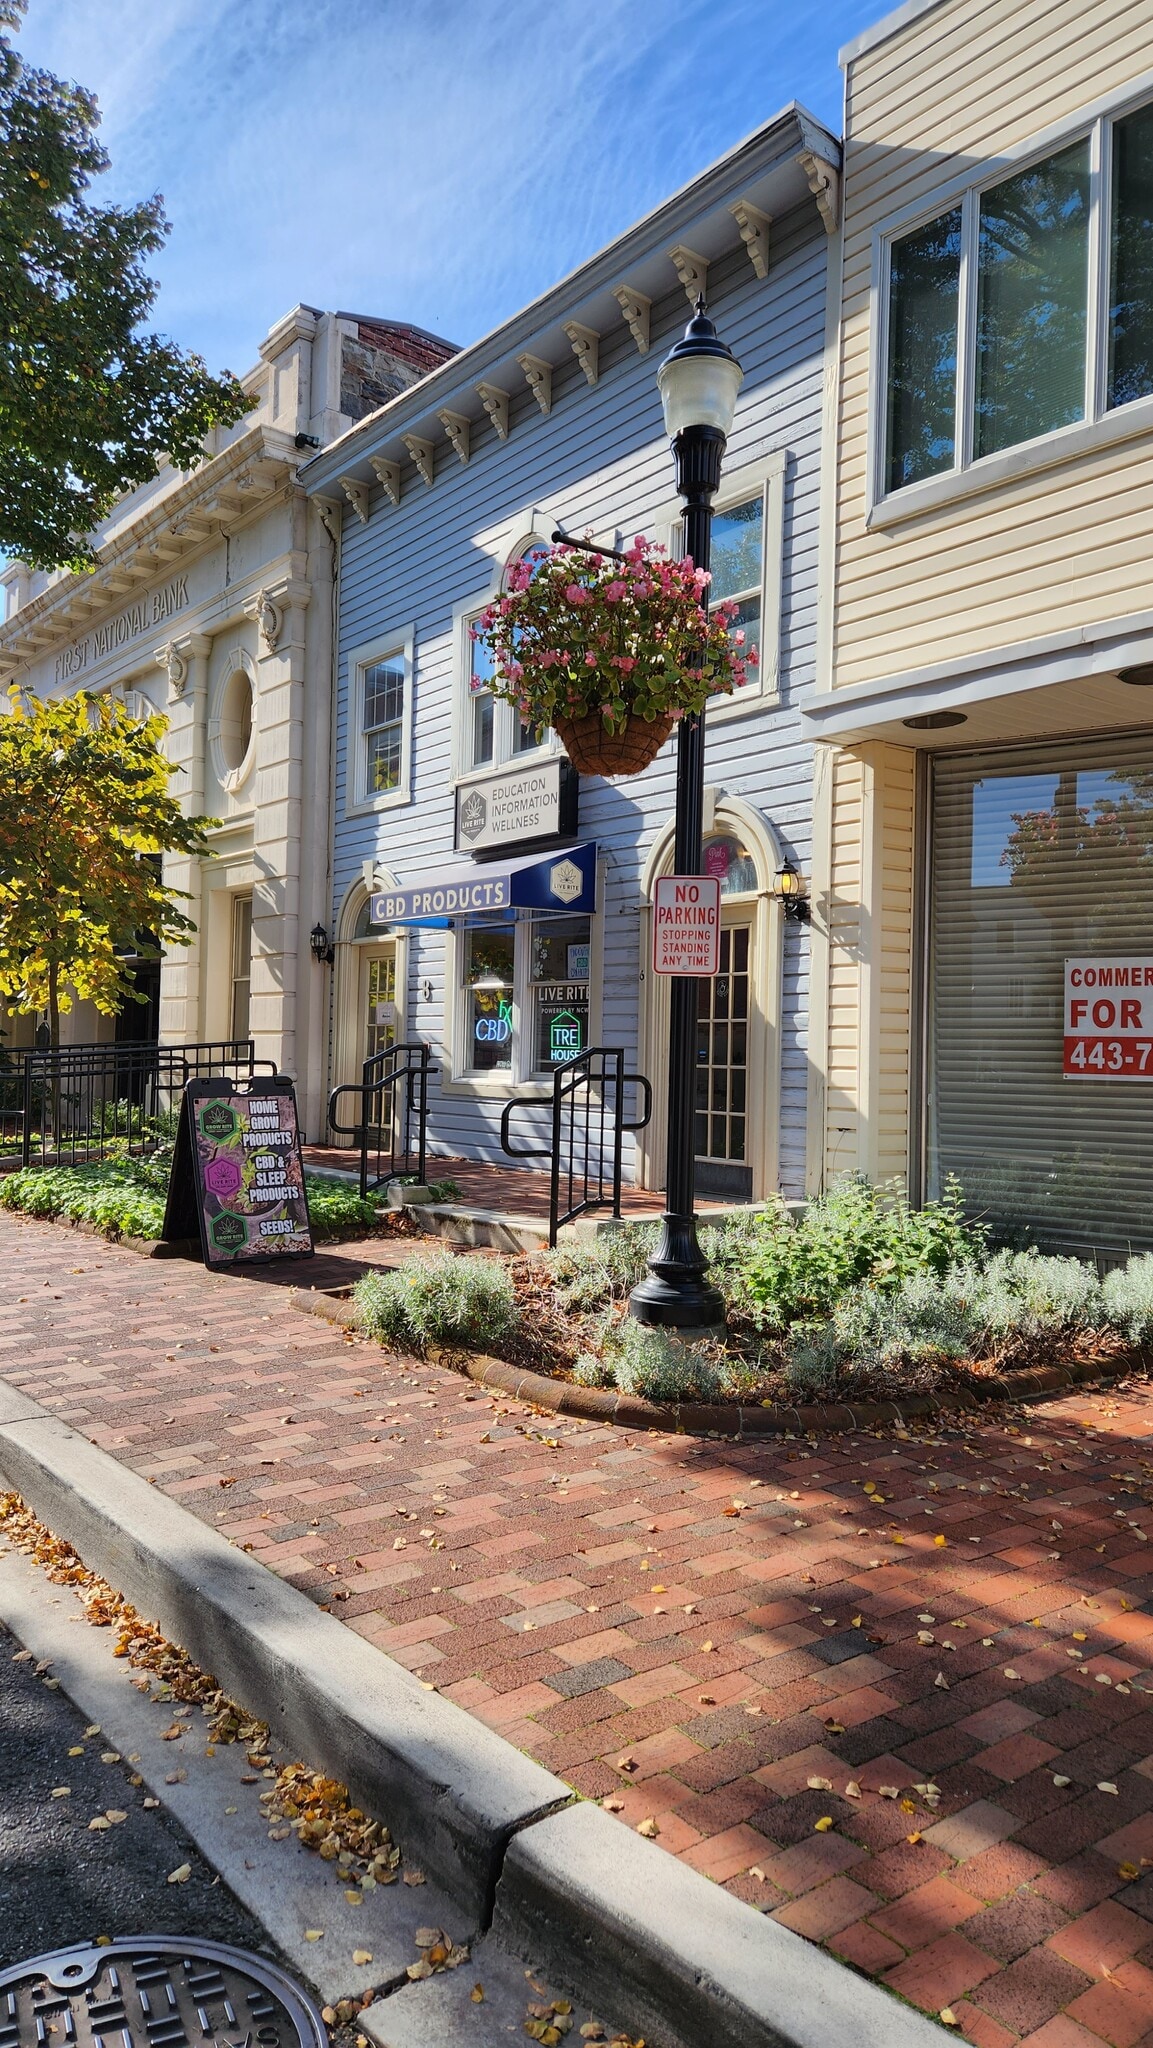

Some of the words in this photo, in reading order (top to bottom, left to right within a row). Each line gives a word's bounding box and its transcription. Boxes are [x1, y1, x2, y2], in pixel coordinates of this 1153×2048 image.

[54, 637, 89, 684] FIRST
[93, 603, 150, 660] NATIONAL
[152, 575, 189, 624] BANK
[492, 777, 546, 801] EDUCATION
[491, 792, 558, 818] INFORMATION
[462, 820, 473, 829] LIVE
[474, 817, 485, 826] RITE
[492, 813, 540, 833] WELLNESS
[375, 897, 406, 919] CBD
[412, 881, 504, 914] PRODUCTS
[675, 885, 699, 903] NO
[658, 906, 715, 925] PARKING
[662, 929, 711, 940] STOPPING
[662, 942, 710, 953] STANDING
[662, 955, 682, 966] ANY
[687, 955, 710, 966] TIME
[1071, 968, 1153, 987] COMMER
[538, 986, 564, 1001] LIVE
[1070, 999, 1143, 1029] FOR
[475, 1018, 508, 1042] CBD
[553, 1028, 578, 1046] TRE
[1071, 1042, 1152, 1070] 443-7
[249, 1100, 279, 1115] HOME
[250, 1115, 280, 1131] GROW
[242, 1131, 293, 1147] PRODUCTS
[255, 1156, 275, 1170] CBD
[277, 1156, 285, 1168] &
[255, 1171, 287, 1187] SLEEP
[249, 1186, 299, 1203] PRODUCTS
[260, 1219, 294, 1236] SEEDS!
